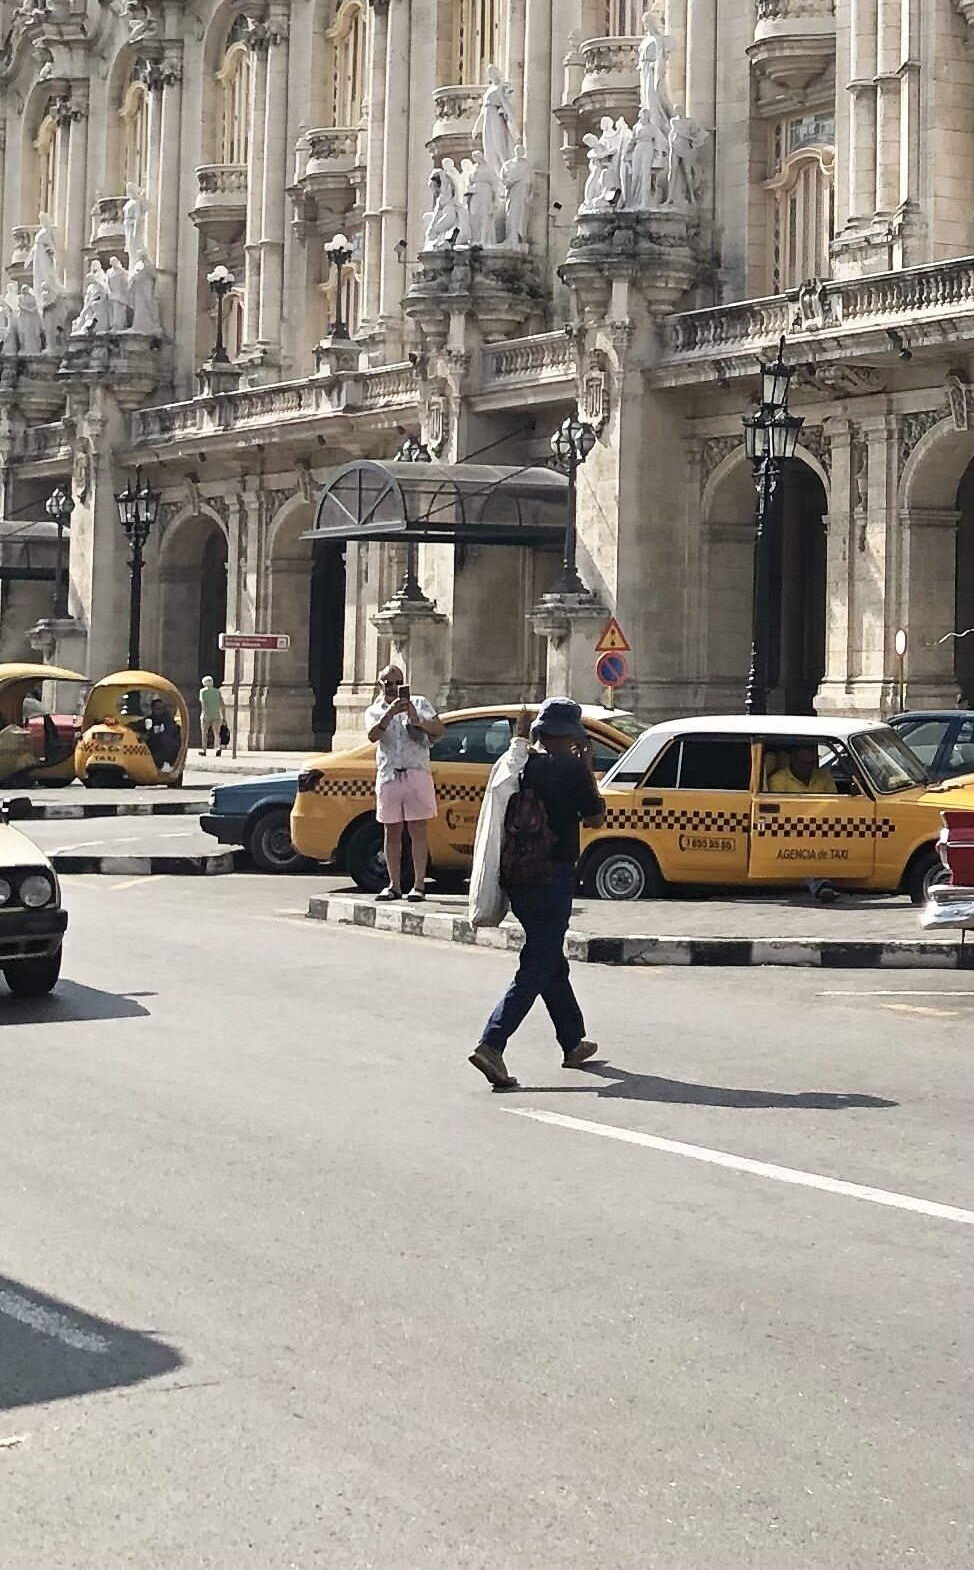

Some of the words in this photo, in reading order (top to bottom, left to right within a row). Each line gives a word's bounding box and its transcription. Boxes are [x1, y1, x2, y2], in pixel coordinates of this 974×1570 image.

[776, 848, 816, 860] AGENCIA
[817, 848, 828, 860] de
[830, 848, 849, 860] TAXI
